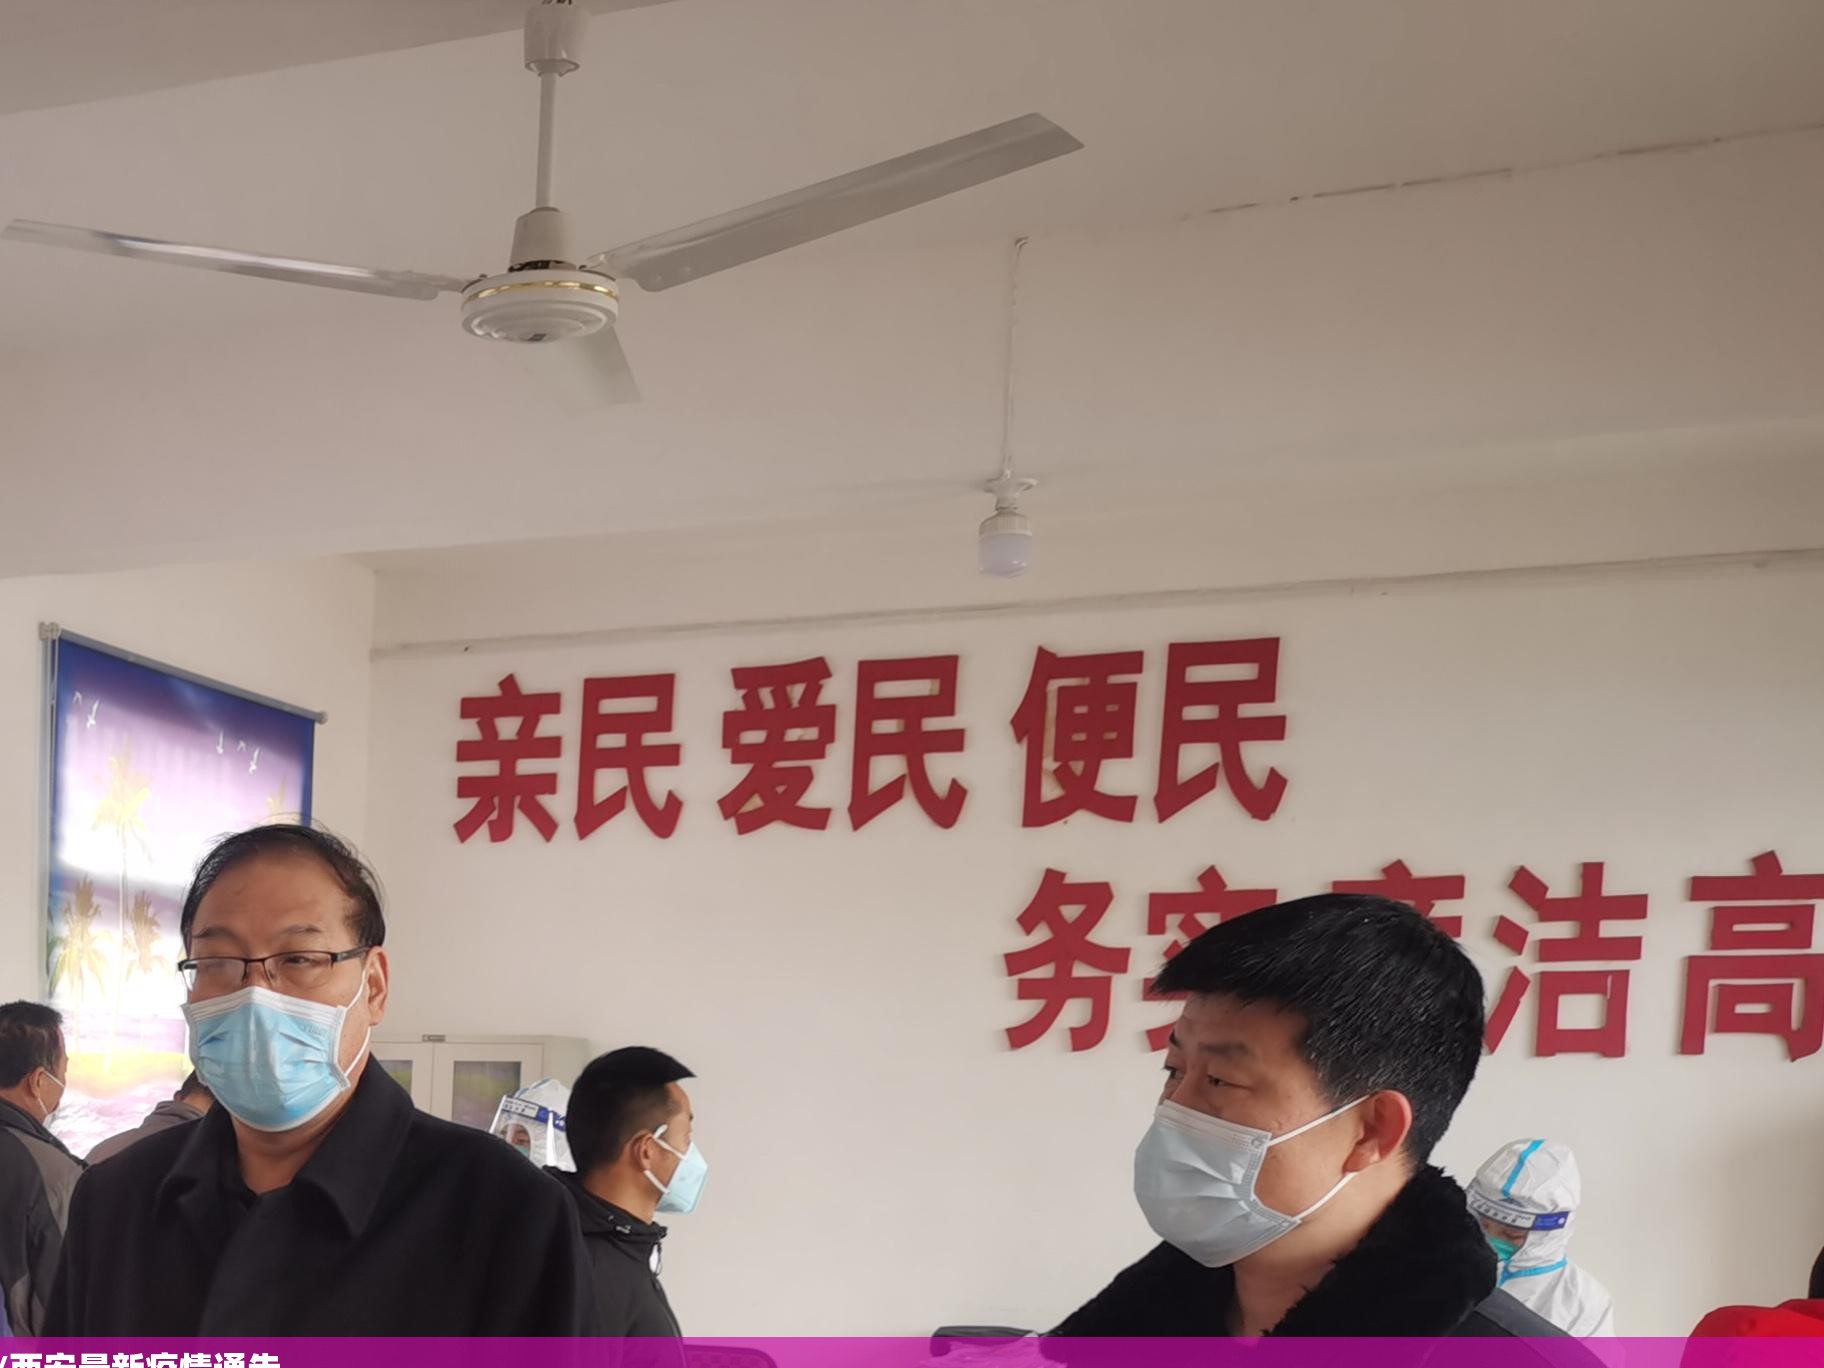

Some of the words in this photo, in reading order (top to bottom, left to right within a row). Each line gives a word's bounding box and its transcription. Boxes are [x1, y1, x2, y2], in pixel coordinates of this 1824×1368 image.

[454, 673, 683, 843] 亲民
[718, 653, 968, 832] 爱民
[1008, 635, 1288, 829] 便民
[1331, 858, 1649, 1058] 洁
[1676, 850, 1824, 1063] 高
